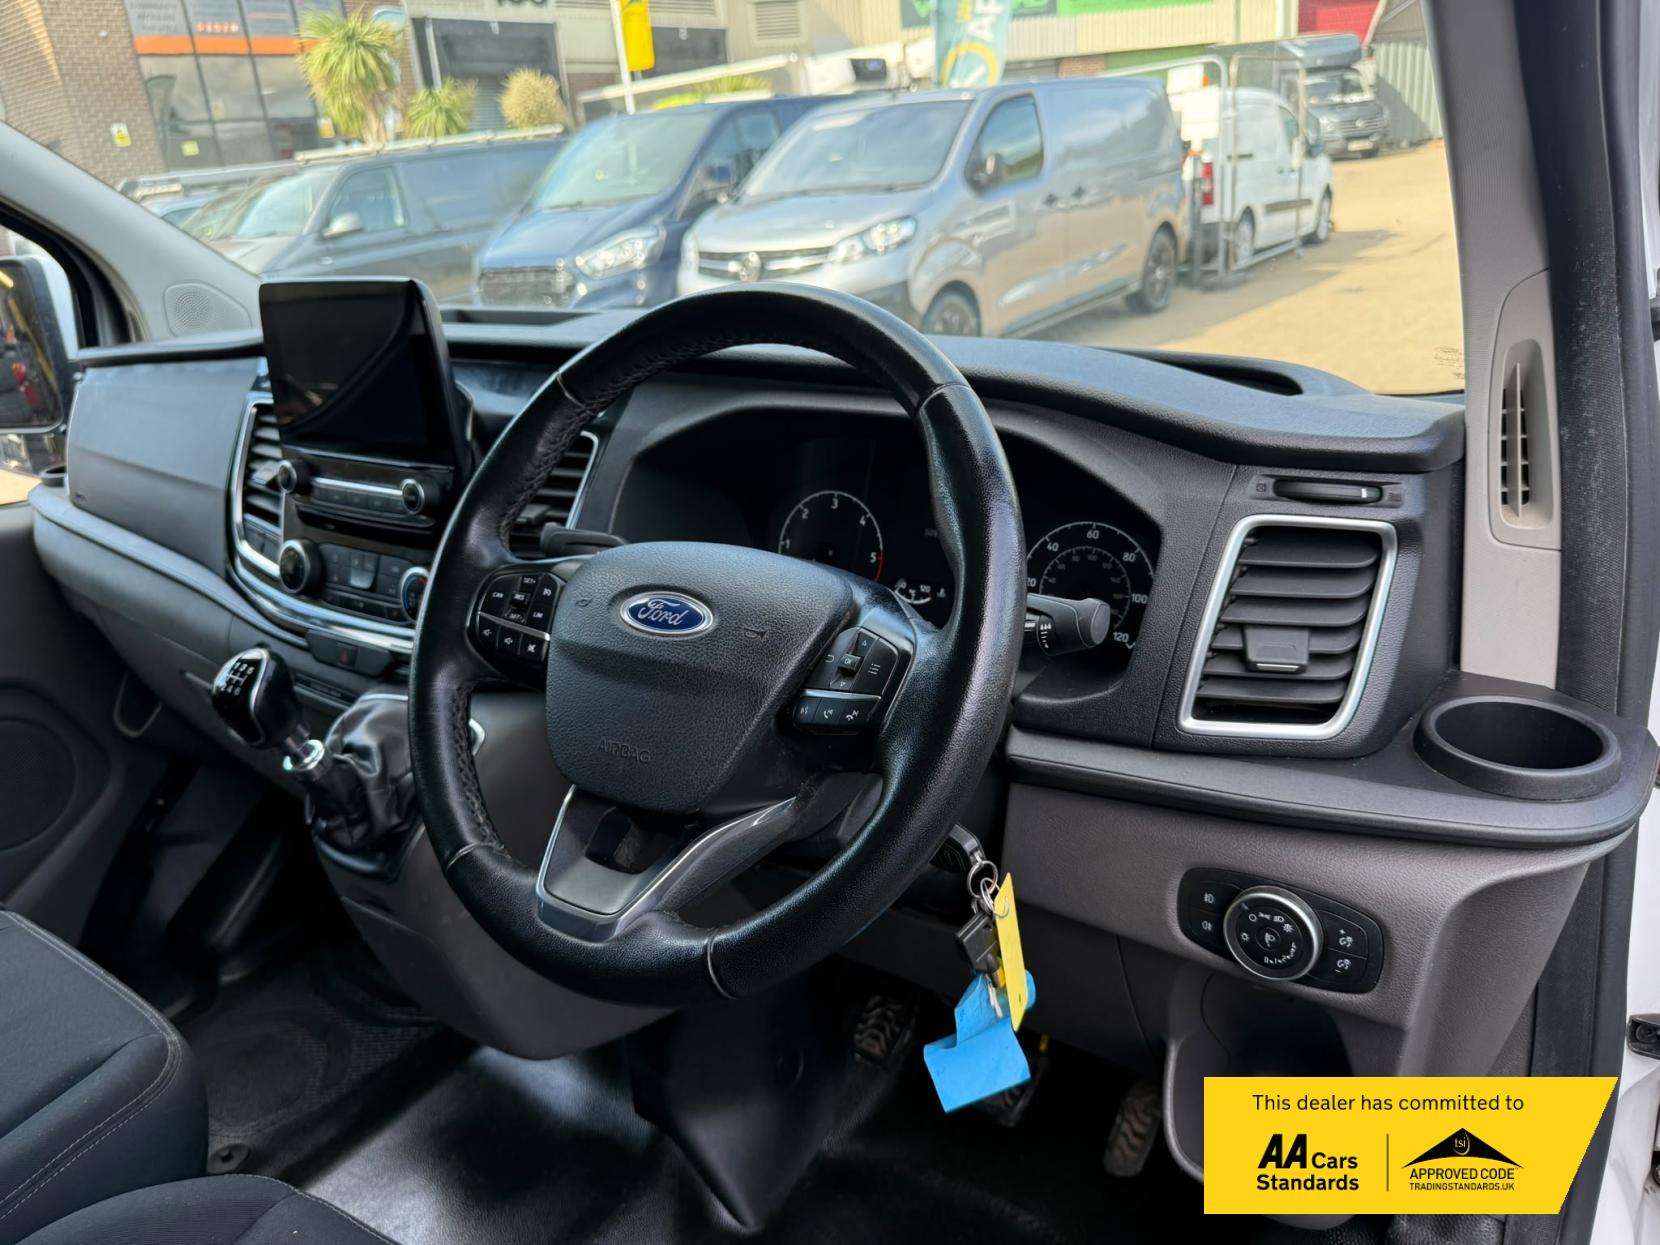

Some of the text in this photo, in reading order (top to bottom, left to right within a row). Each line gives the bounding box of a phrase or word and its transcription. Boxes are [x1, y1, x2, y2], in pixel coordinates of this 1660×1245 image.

[832, 499, 838, 509] 3
[802, 509, 808, 519] 2
[860, 516, 866, 526] 4
[1086, 530, 1099, 539] 60
[1046, 542, 1059, 551] 40
[870, 552, 876, 562] 5
[1122, 552, 1136, 562] 80
[1131, 593, 1148, 604] 100
[637, 598, 689, 626] Ford
[1113, 631, 1129, 642] 120
